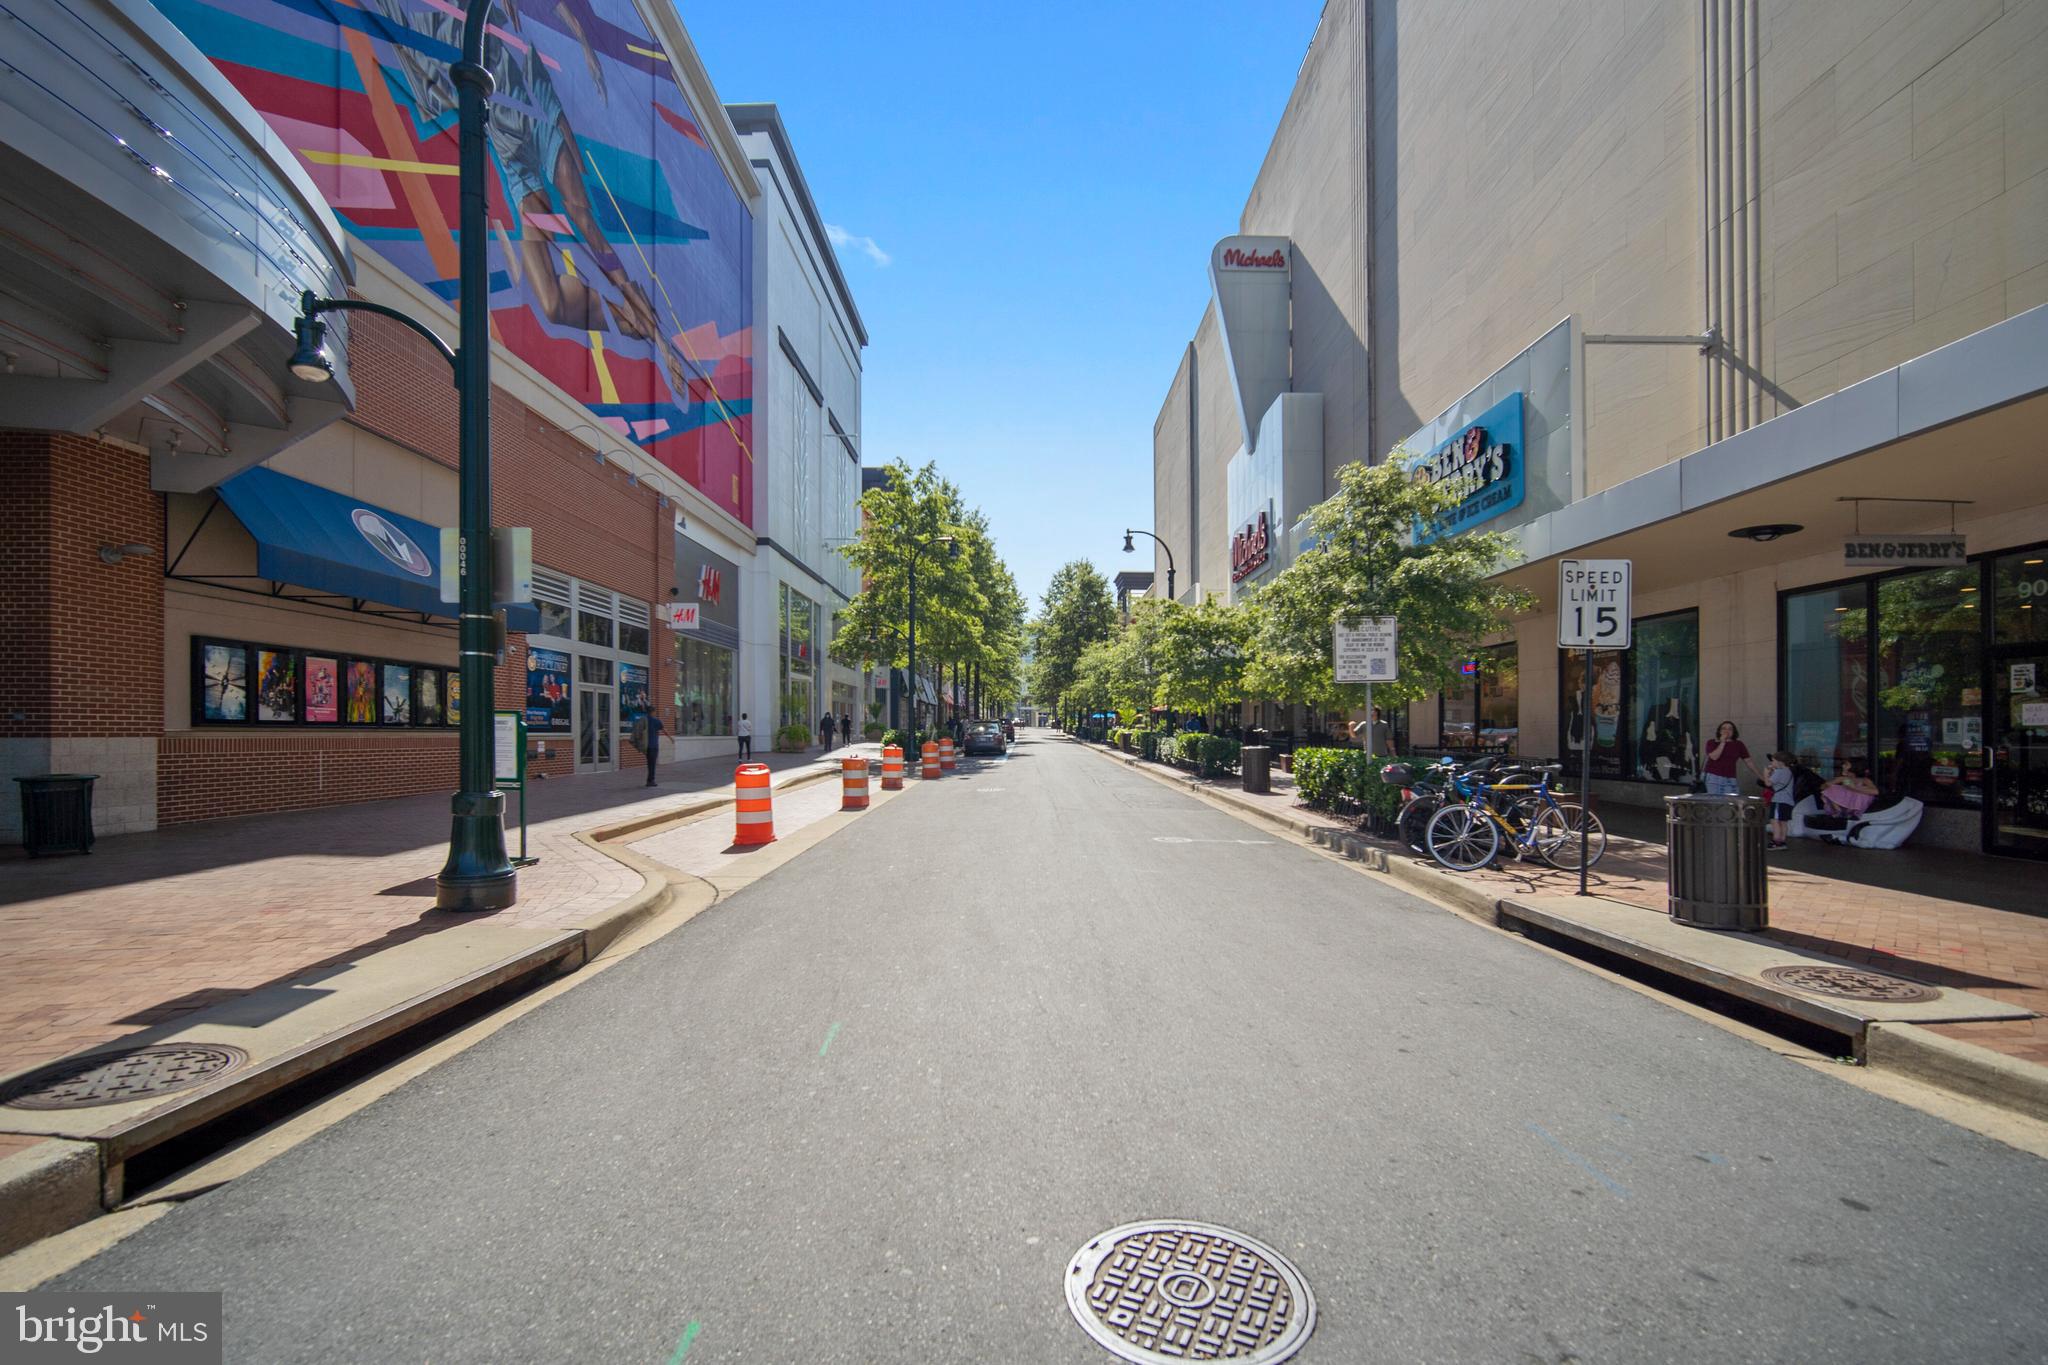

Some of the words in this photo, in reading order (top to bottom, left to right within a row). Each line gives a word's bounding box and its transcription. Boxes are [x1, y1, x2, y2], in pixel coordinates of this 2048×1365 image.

[1223, 248, 1285, 268] Michaels
[1565, 570, 1623, 584] SPEED
[1571, 588, 1617, 602] LIMIT
[1575, 606, 1618, 637] 15
